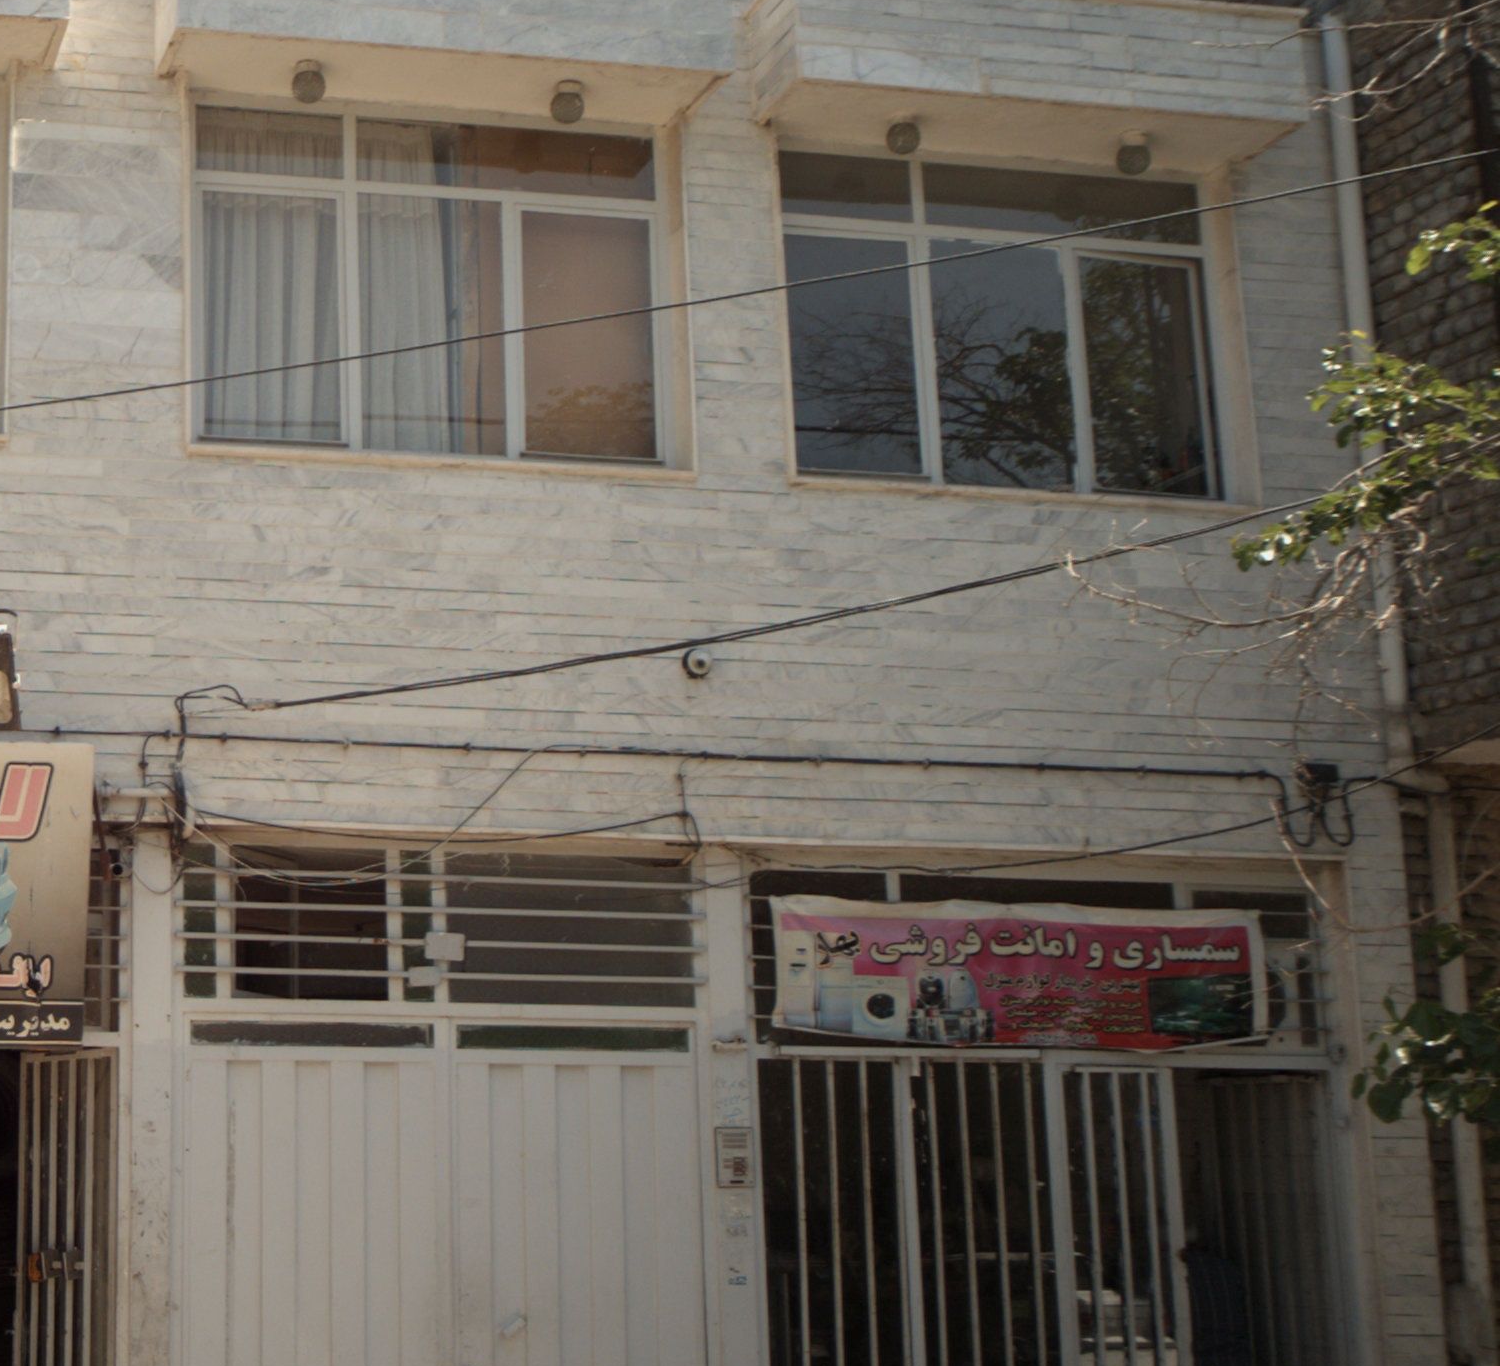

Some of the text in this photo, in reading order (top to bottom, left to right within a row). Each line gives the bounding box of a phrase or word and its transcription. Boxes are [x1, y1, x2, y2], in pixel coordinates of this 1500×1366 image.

[870, 922, 982, 966] فروشی
[989, 926, 1075, 958] امانت
[1085, 943, 1105, 968] و
[1113, 934, 1241, 970] سمساری
